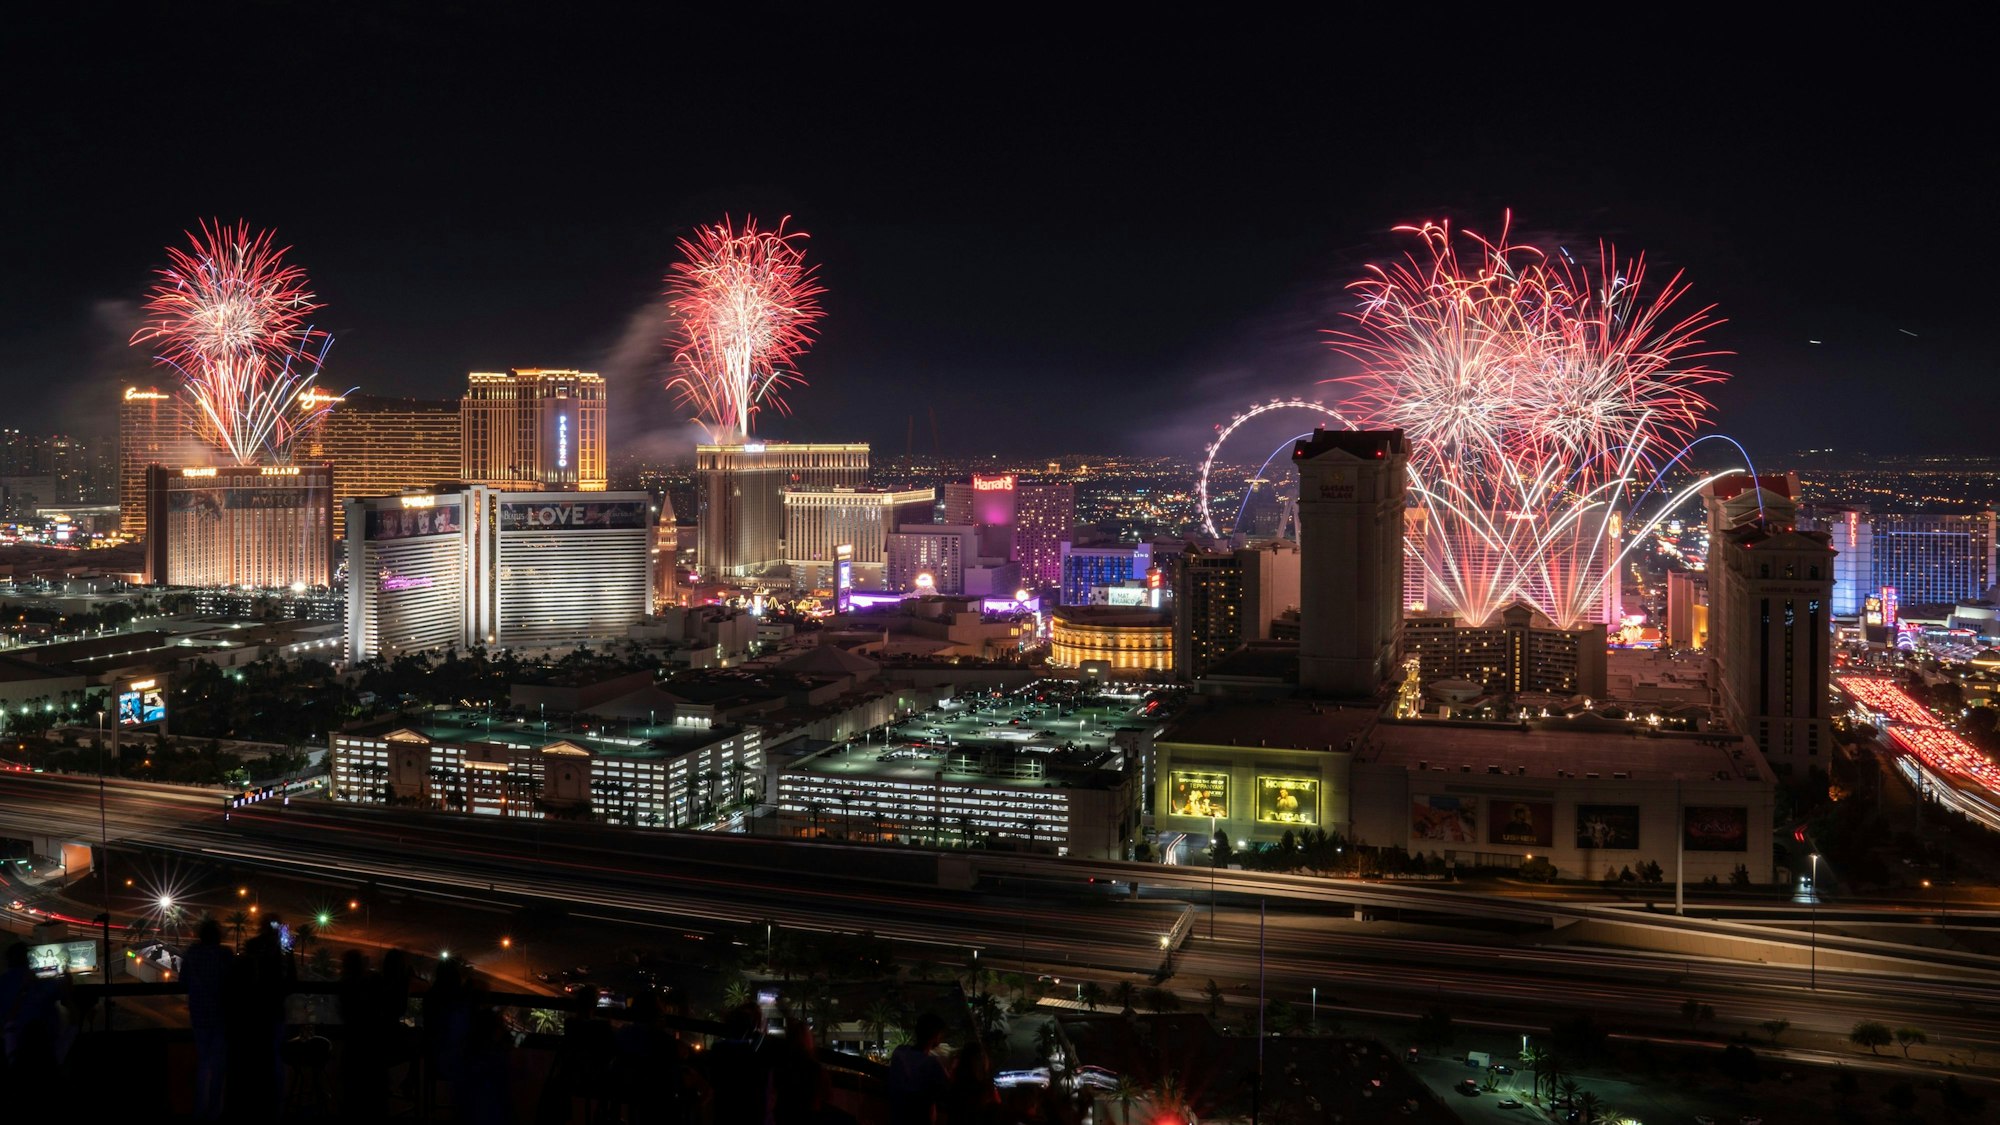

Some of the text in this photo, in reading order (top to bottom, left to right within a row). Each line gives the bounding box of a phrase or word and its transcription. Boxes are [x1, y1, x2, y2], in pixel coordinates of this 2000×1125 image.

[559, 415, 567, 466] PALAZZO
[261, 467, 300, 475] ISLAND
[973, 476, 1013, 490] Harrah's
[527, 507, 585, 525] LOVE
[1274, 812, 1306, 822] VEGAS
